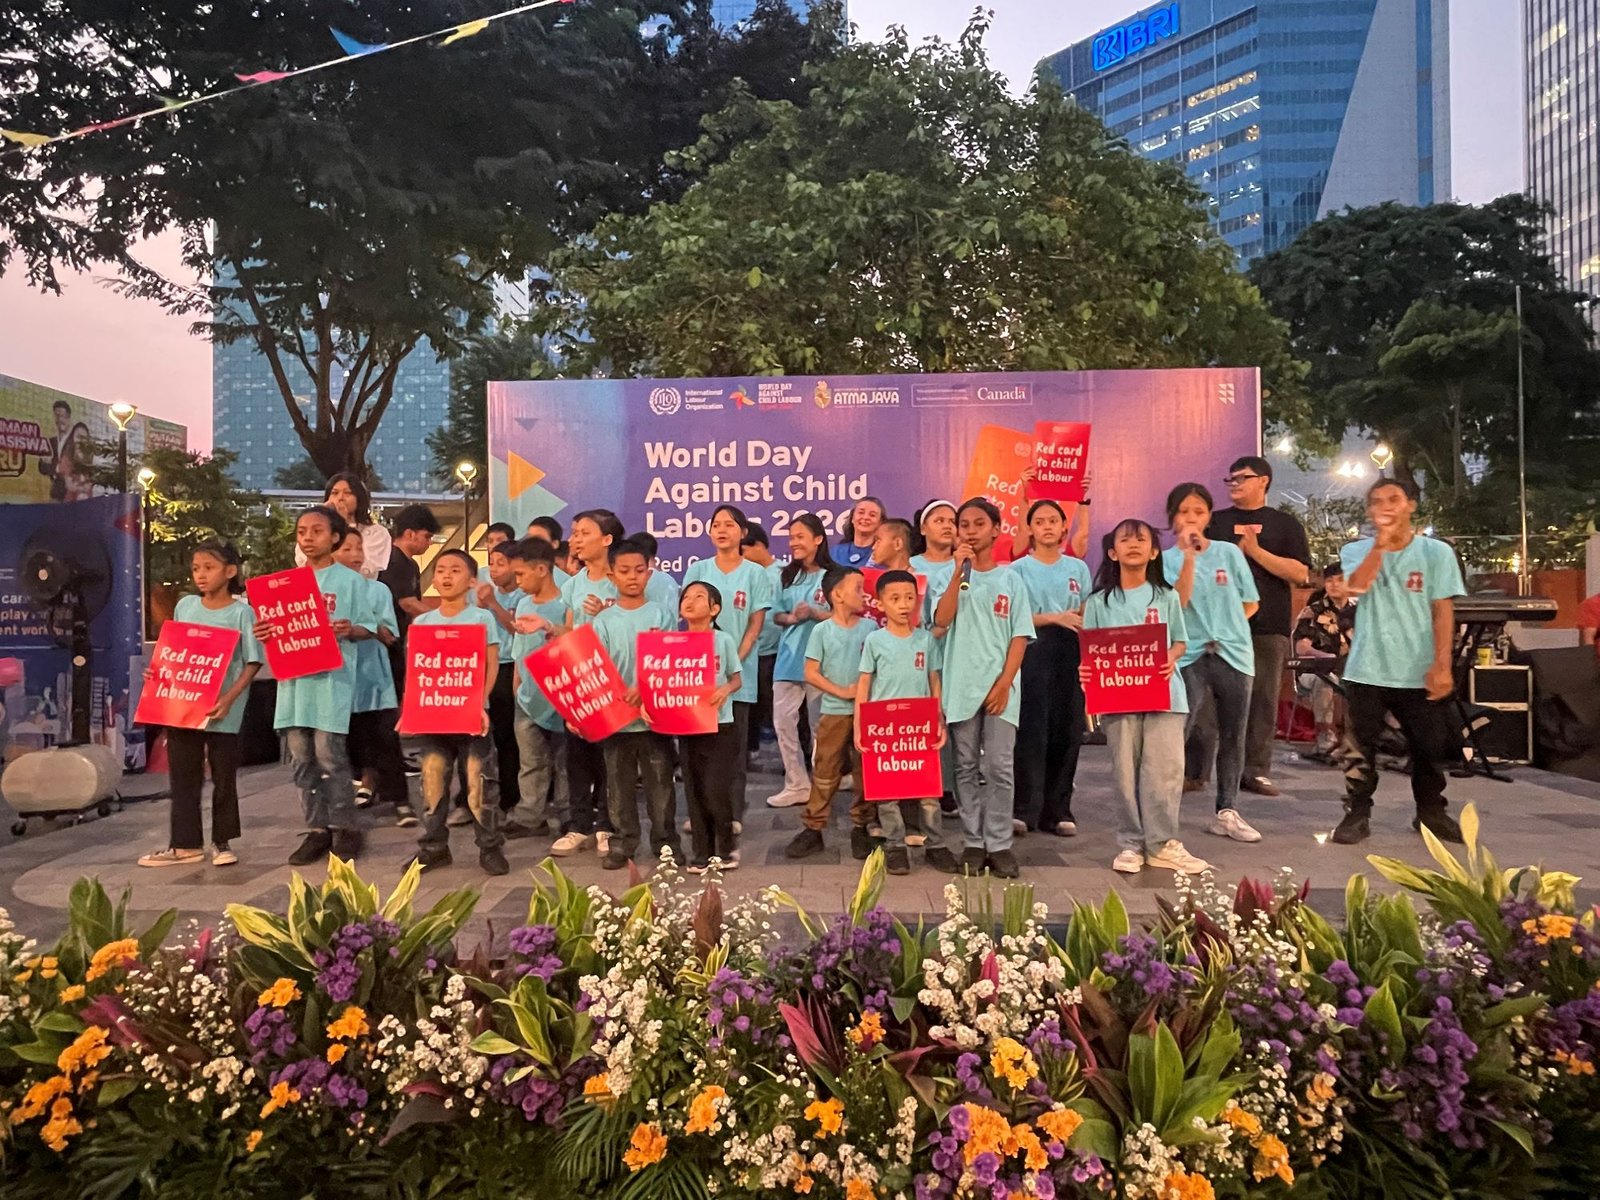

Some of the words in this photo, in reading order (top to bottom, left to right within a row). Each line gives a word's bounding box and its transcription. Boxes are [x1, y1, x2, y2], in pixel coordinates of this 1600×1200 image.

[1127, 3, 1179, 55] BRI
[834, 392, 866, 405] ATMA
[869, 391, 899, 404] JAYA
[977, 386, 1026, 401] Canada
[644, 440, 737, 468] World
[748, 440, 812, 472] Day
[1036, 442, 1055, 455] Red
[1058, 444, 1083, 457] card
[1037, 457, 1048, 468] to
[1051, 458, 1077, 470] child
[986, 474, 1022, 496] Red
[1037, 470, 1073, 483] labour
[644, 474, 774, 509] Against
[783, 473, 867, 500] Child
[258, 601, 285, 621] Red
[287, 593, 317, 613] card
[287, 612, 320, 633] child
[278, 636, 321, 654] labour
[1088, 643, 1117, 654] Red
[1123, 641, 1158, 653] card
[159, 646, 185, 663] Red
[189, 652, 224, 668] card
[414, 652, 441, 669] Red
[445, 652, 478, 668] card
[643, 654, 670, 671] Red
[674, 653, 707, 669] card
[1094, 656, 1110, 670] to
[1116, 653, 1155, 668] child
[159, 664, 172, 679] to
[175, 668, 213, 684] child
[418, 672, 432, 687] to
[437, 671, 473, 687] child
[544, 666, 571, 693] Red
[573, 649, 604, 676] card
[649, 672, 663, 688] to
[668, 670, 704, 687] child
[1100, 671, 1152, 688] labour
[156, 683, 202, 701] labour
[559, 690, 574, 707] to
[576, 667, 610, 699] child
[420, 690, 468, 707] labour
[570, 690, 614, 723] labour
[653, 692, 700, 710] labour
[867, 724, 895, 737] Red
[898, 721, 930, 735] card
[872, 740, 890, 753] to
[892, 737, 927, 752] child
[877, 756, 925, 772] labour
